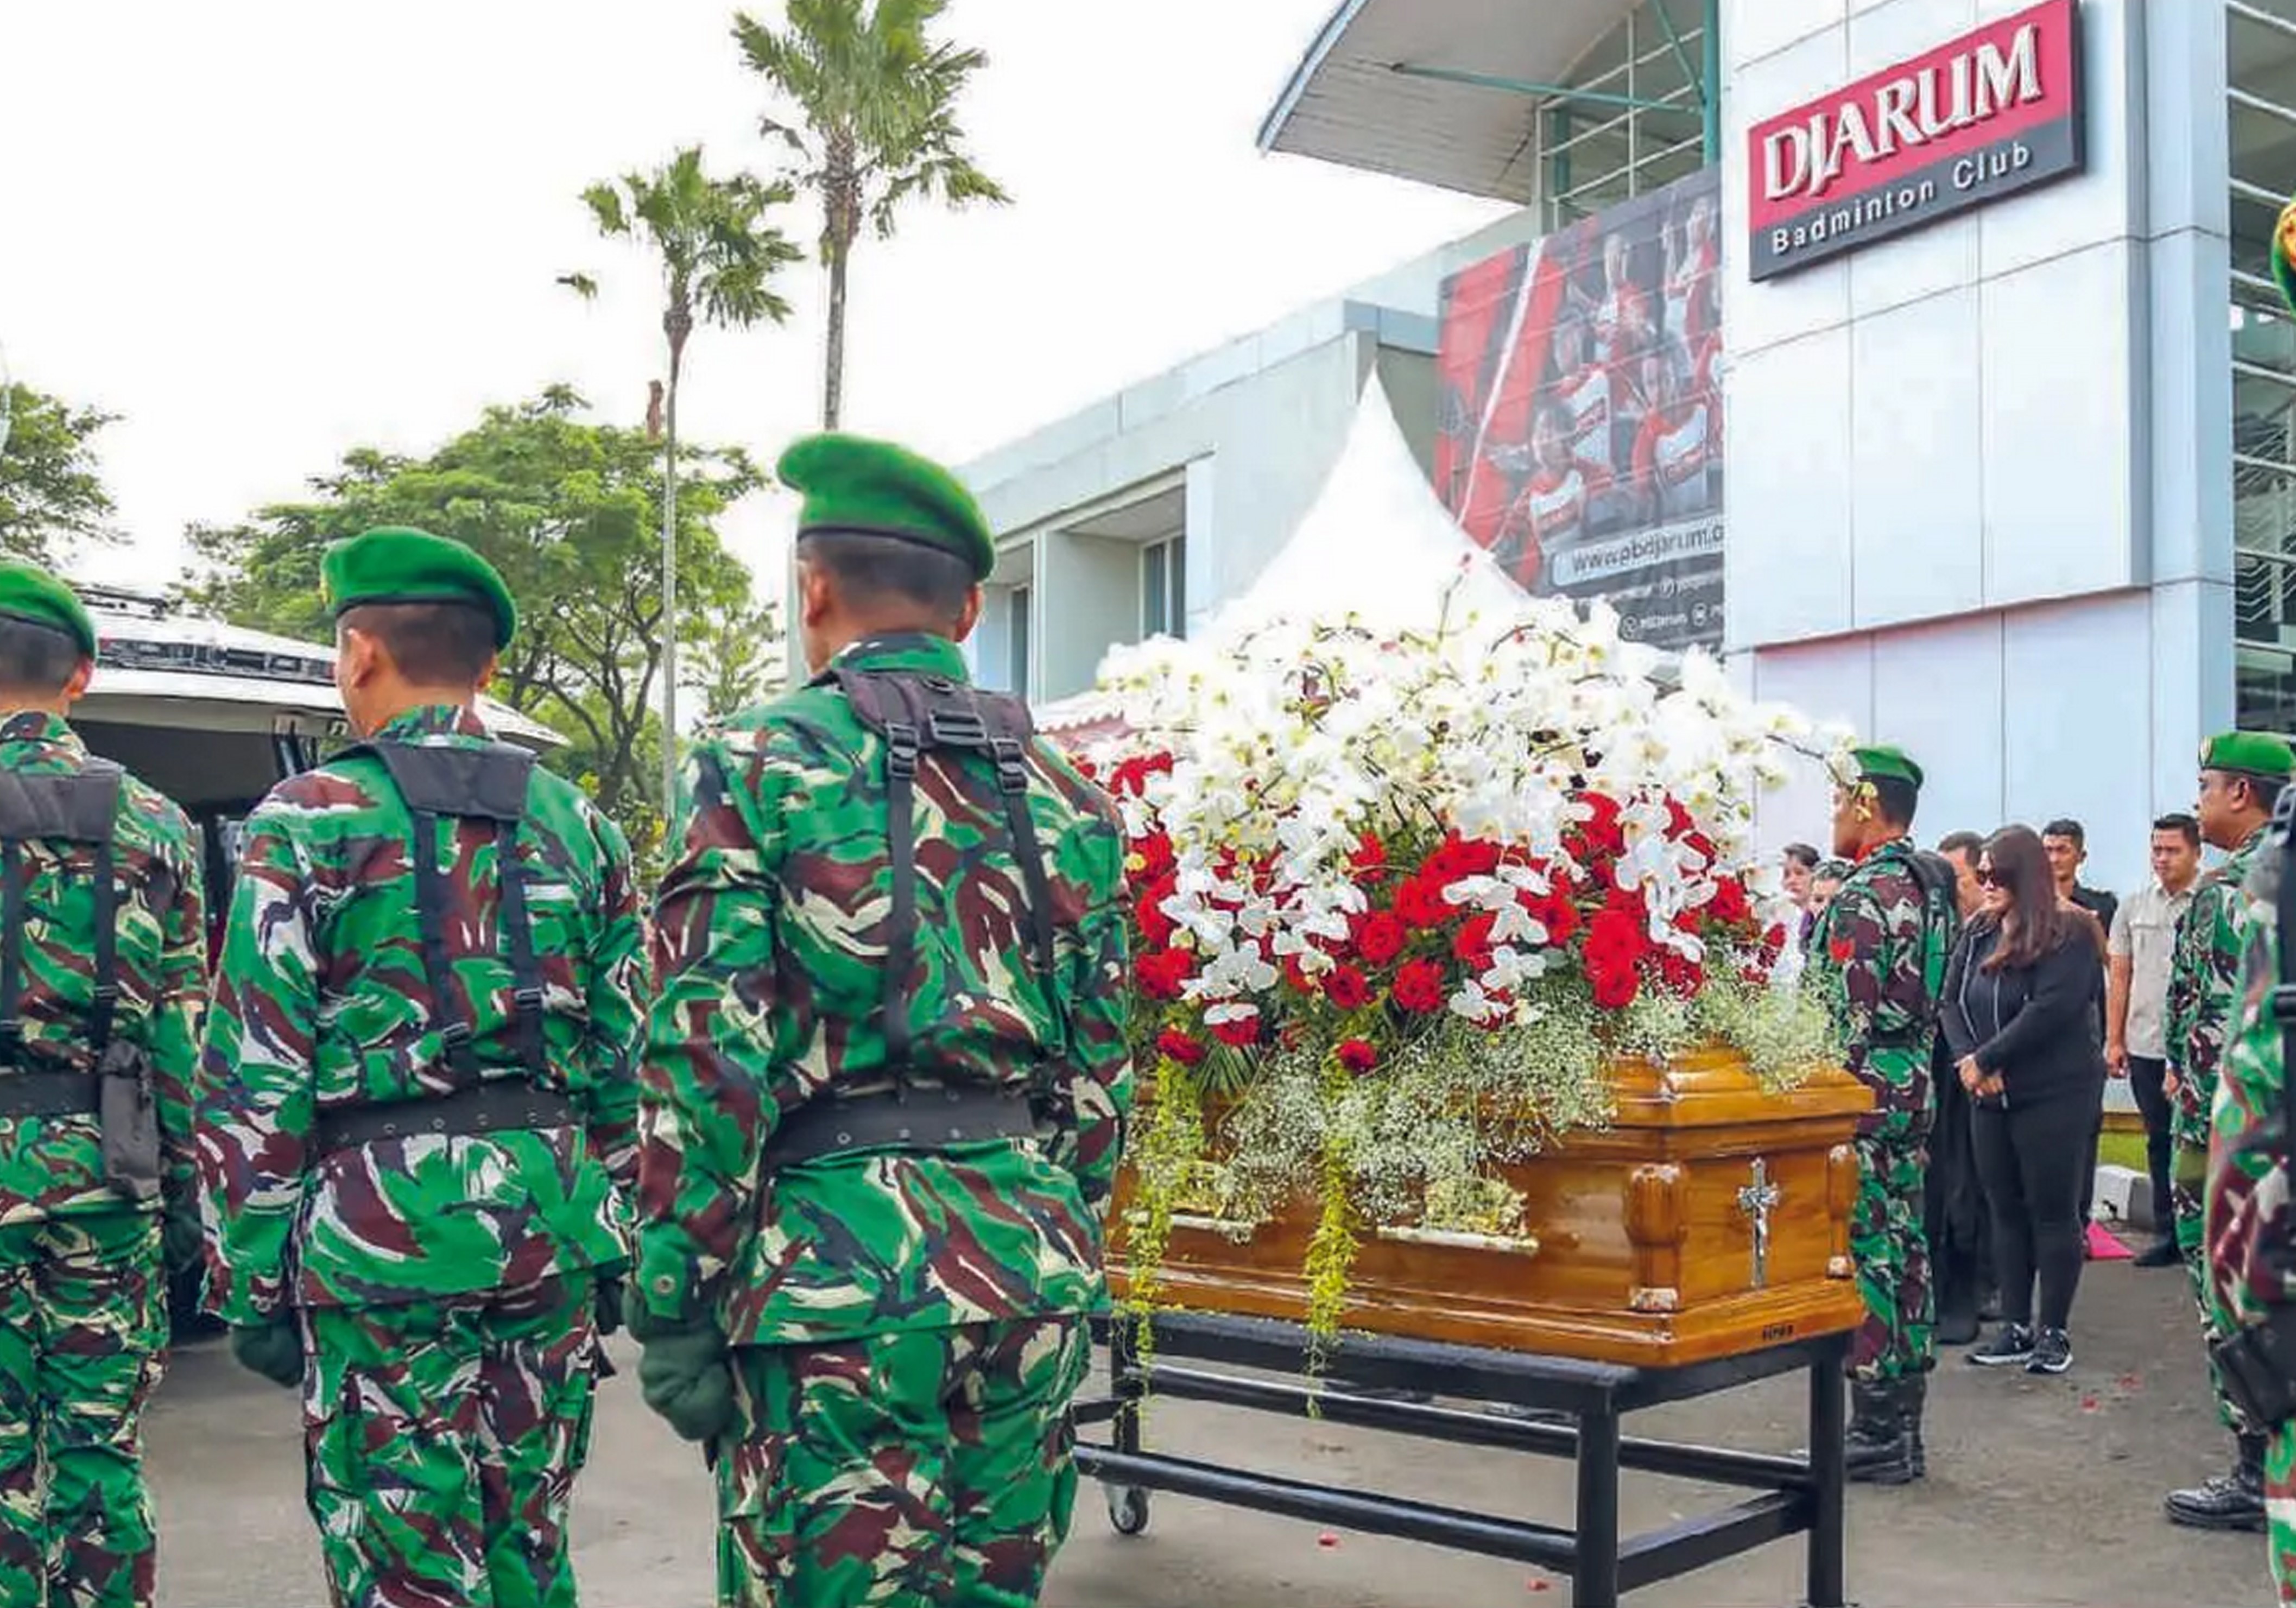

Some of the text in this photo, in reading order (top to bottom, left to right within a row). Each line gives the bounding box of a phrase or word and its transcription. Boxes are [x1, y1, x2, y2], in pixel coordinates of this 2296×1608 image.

[1764, 23, 2042, 199] DJARUM
[1772, 142, 2030, 254] Badminton Club
